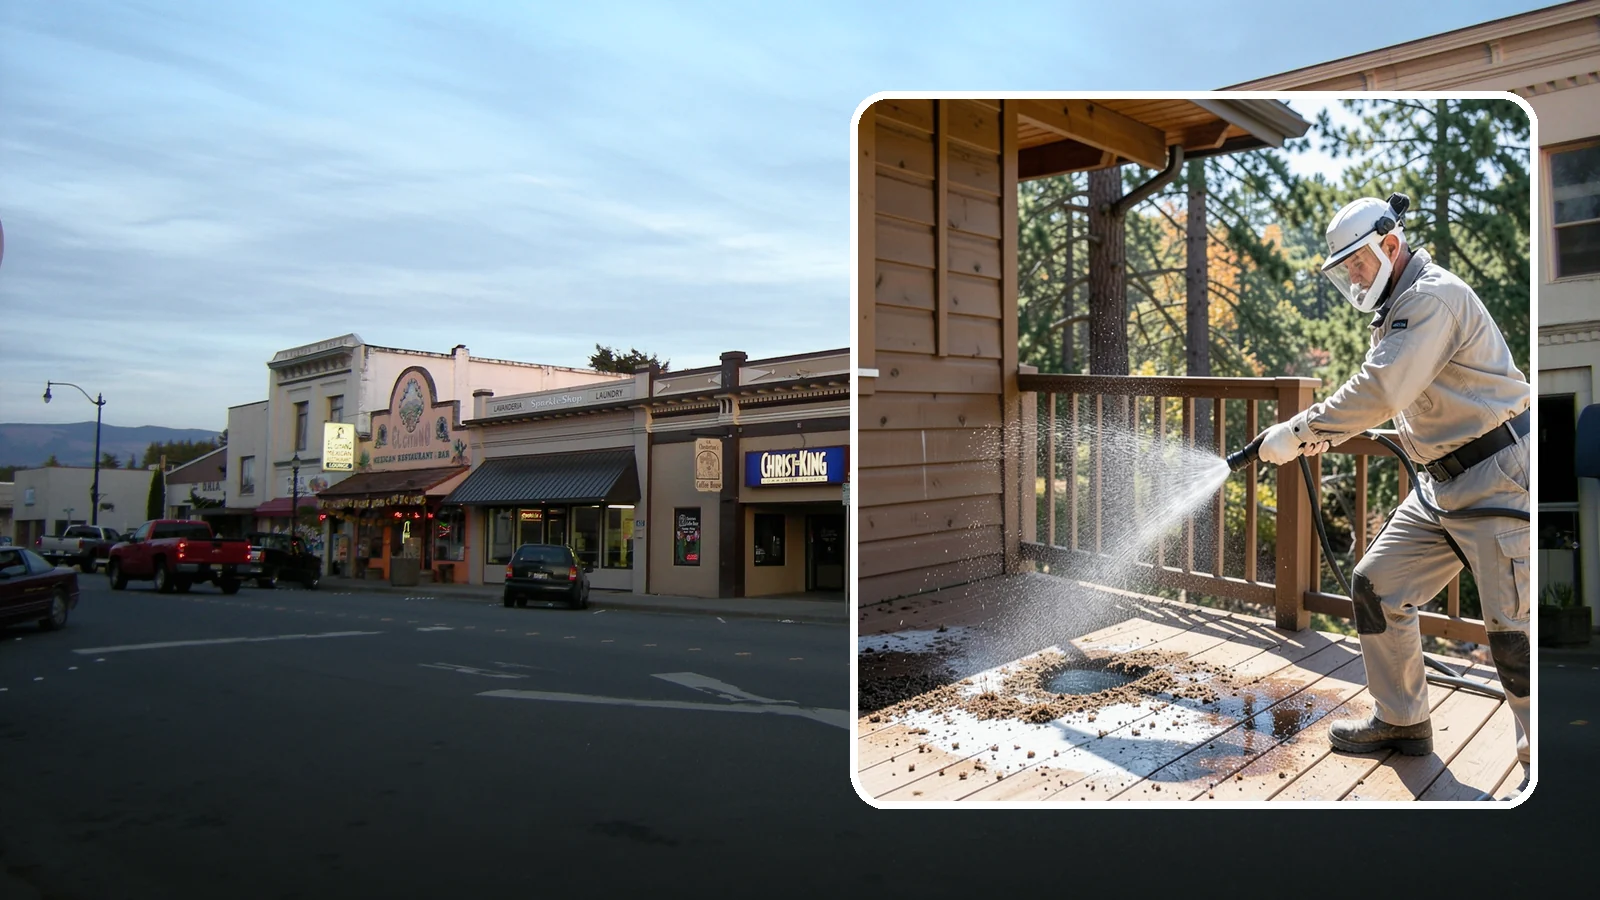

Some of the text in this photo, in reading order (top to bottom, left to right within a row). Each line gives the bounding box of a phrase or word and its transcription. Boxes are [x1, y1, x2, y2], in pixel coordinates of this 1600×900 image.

[595, 389, 624, 400] LAUNDRY
[493, 402, 523, 413] LAVANDERIA
[530, 394, 583, 409] Sparkle Shop
[373, 455, 396, 464] MEXICAN
[397, 451, 433, 462] RESTAURANT
[437, 450, 450, 459] BAR
[761, 450, 827, 478] CHRIST KING
[696, 481, 709, 489] Coffee
